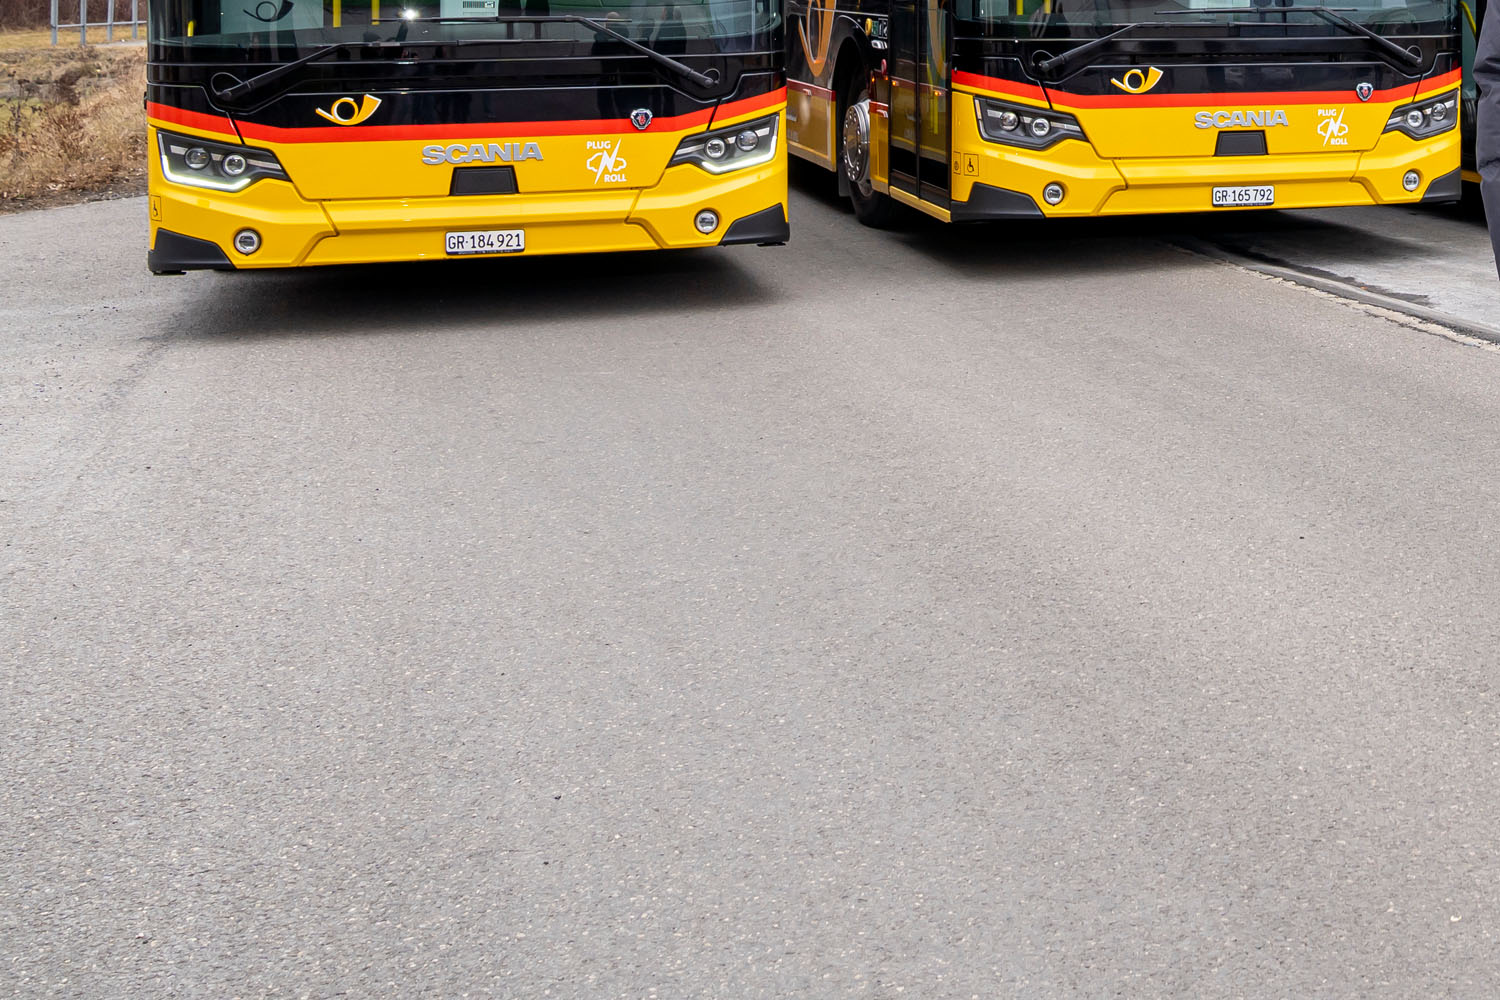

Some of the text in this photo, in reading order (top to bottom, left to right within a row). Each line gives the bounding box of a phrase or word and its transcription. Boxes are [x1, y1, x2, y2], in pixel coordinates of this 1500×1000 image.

[1317, 109, 1337, 117] PLUG
[1194, 110, 1288, 129] SCANIA
[586, 140, 611, 150] PLUG
[1330, 137, 1348, 145] ROLL
[422, 142, 544, 165] SCANIA
[604, 173, 627, 183] ROLL
[1253, 188, 1273, 201] 792
[497, 233, 522, 248] 921
